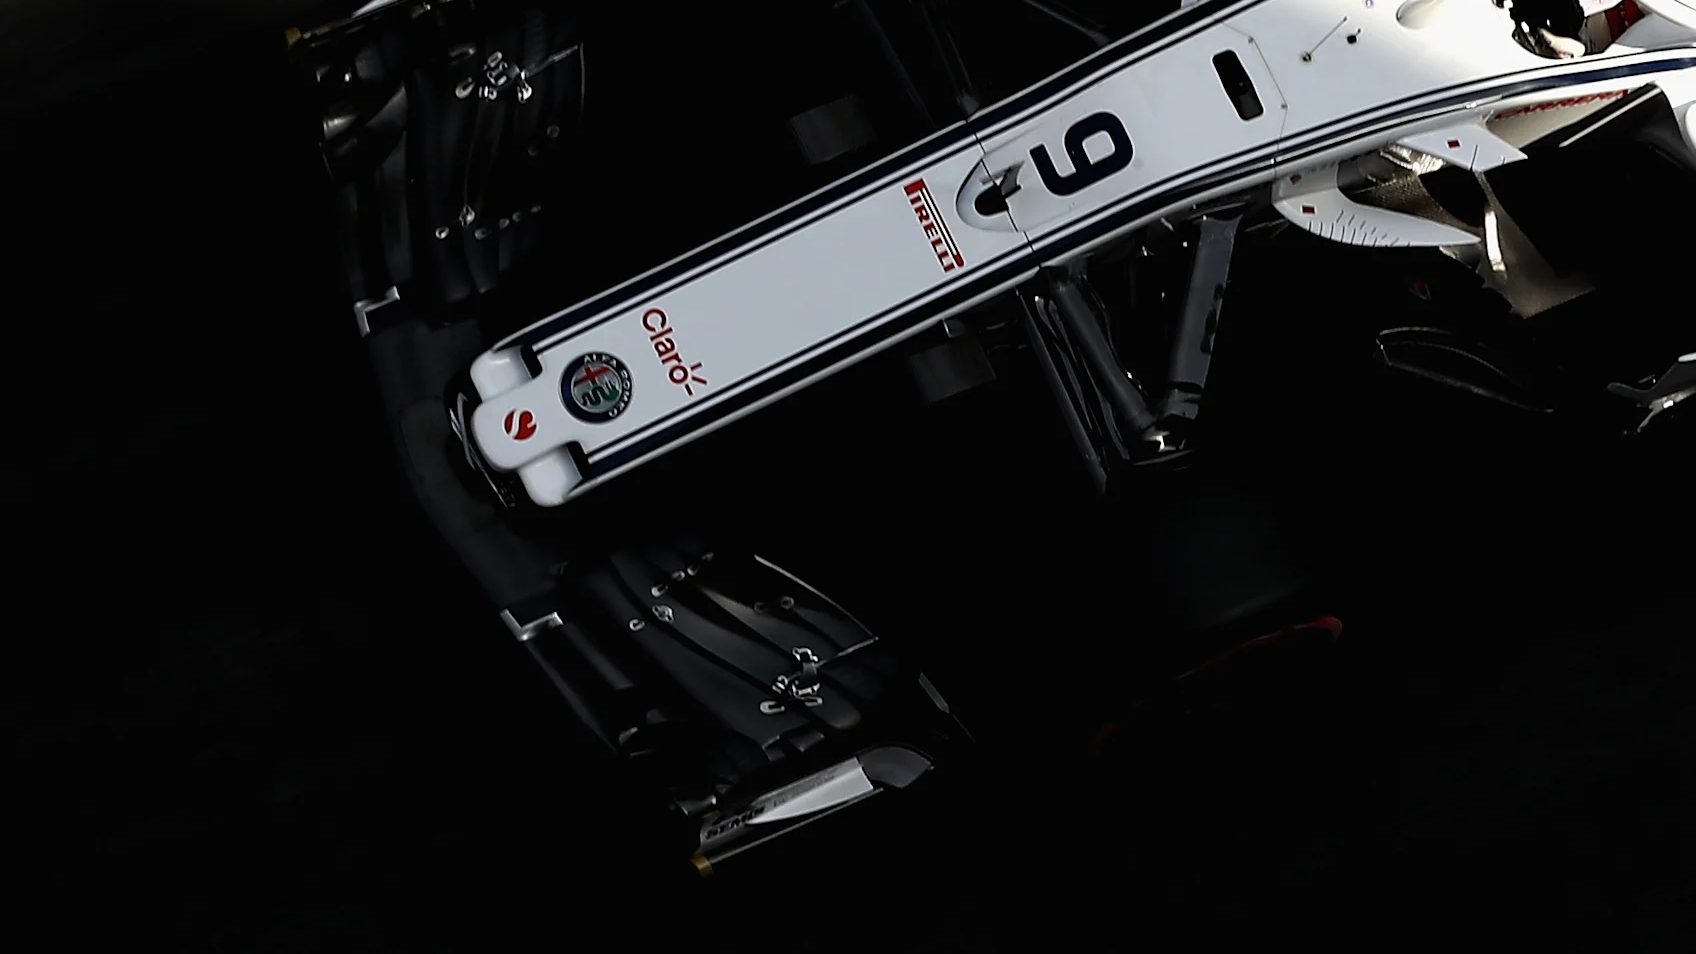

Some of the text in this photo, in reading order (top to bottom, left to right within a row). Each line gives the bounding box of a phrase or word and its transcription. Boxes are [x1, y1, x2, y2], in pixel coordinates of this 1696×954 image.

[1030, 111, 1134, 197] 9
[903, 177, 965, 273] PIRELLI
[642, 308, 690, 385] Claro
